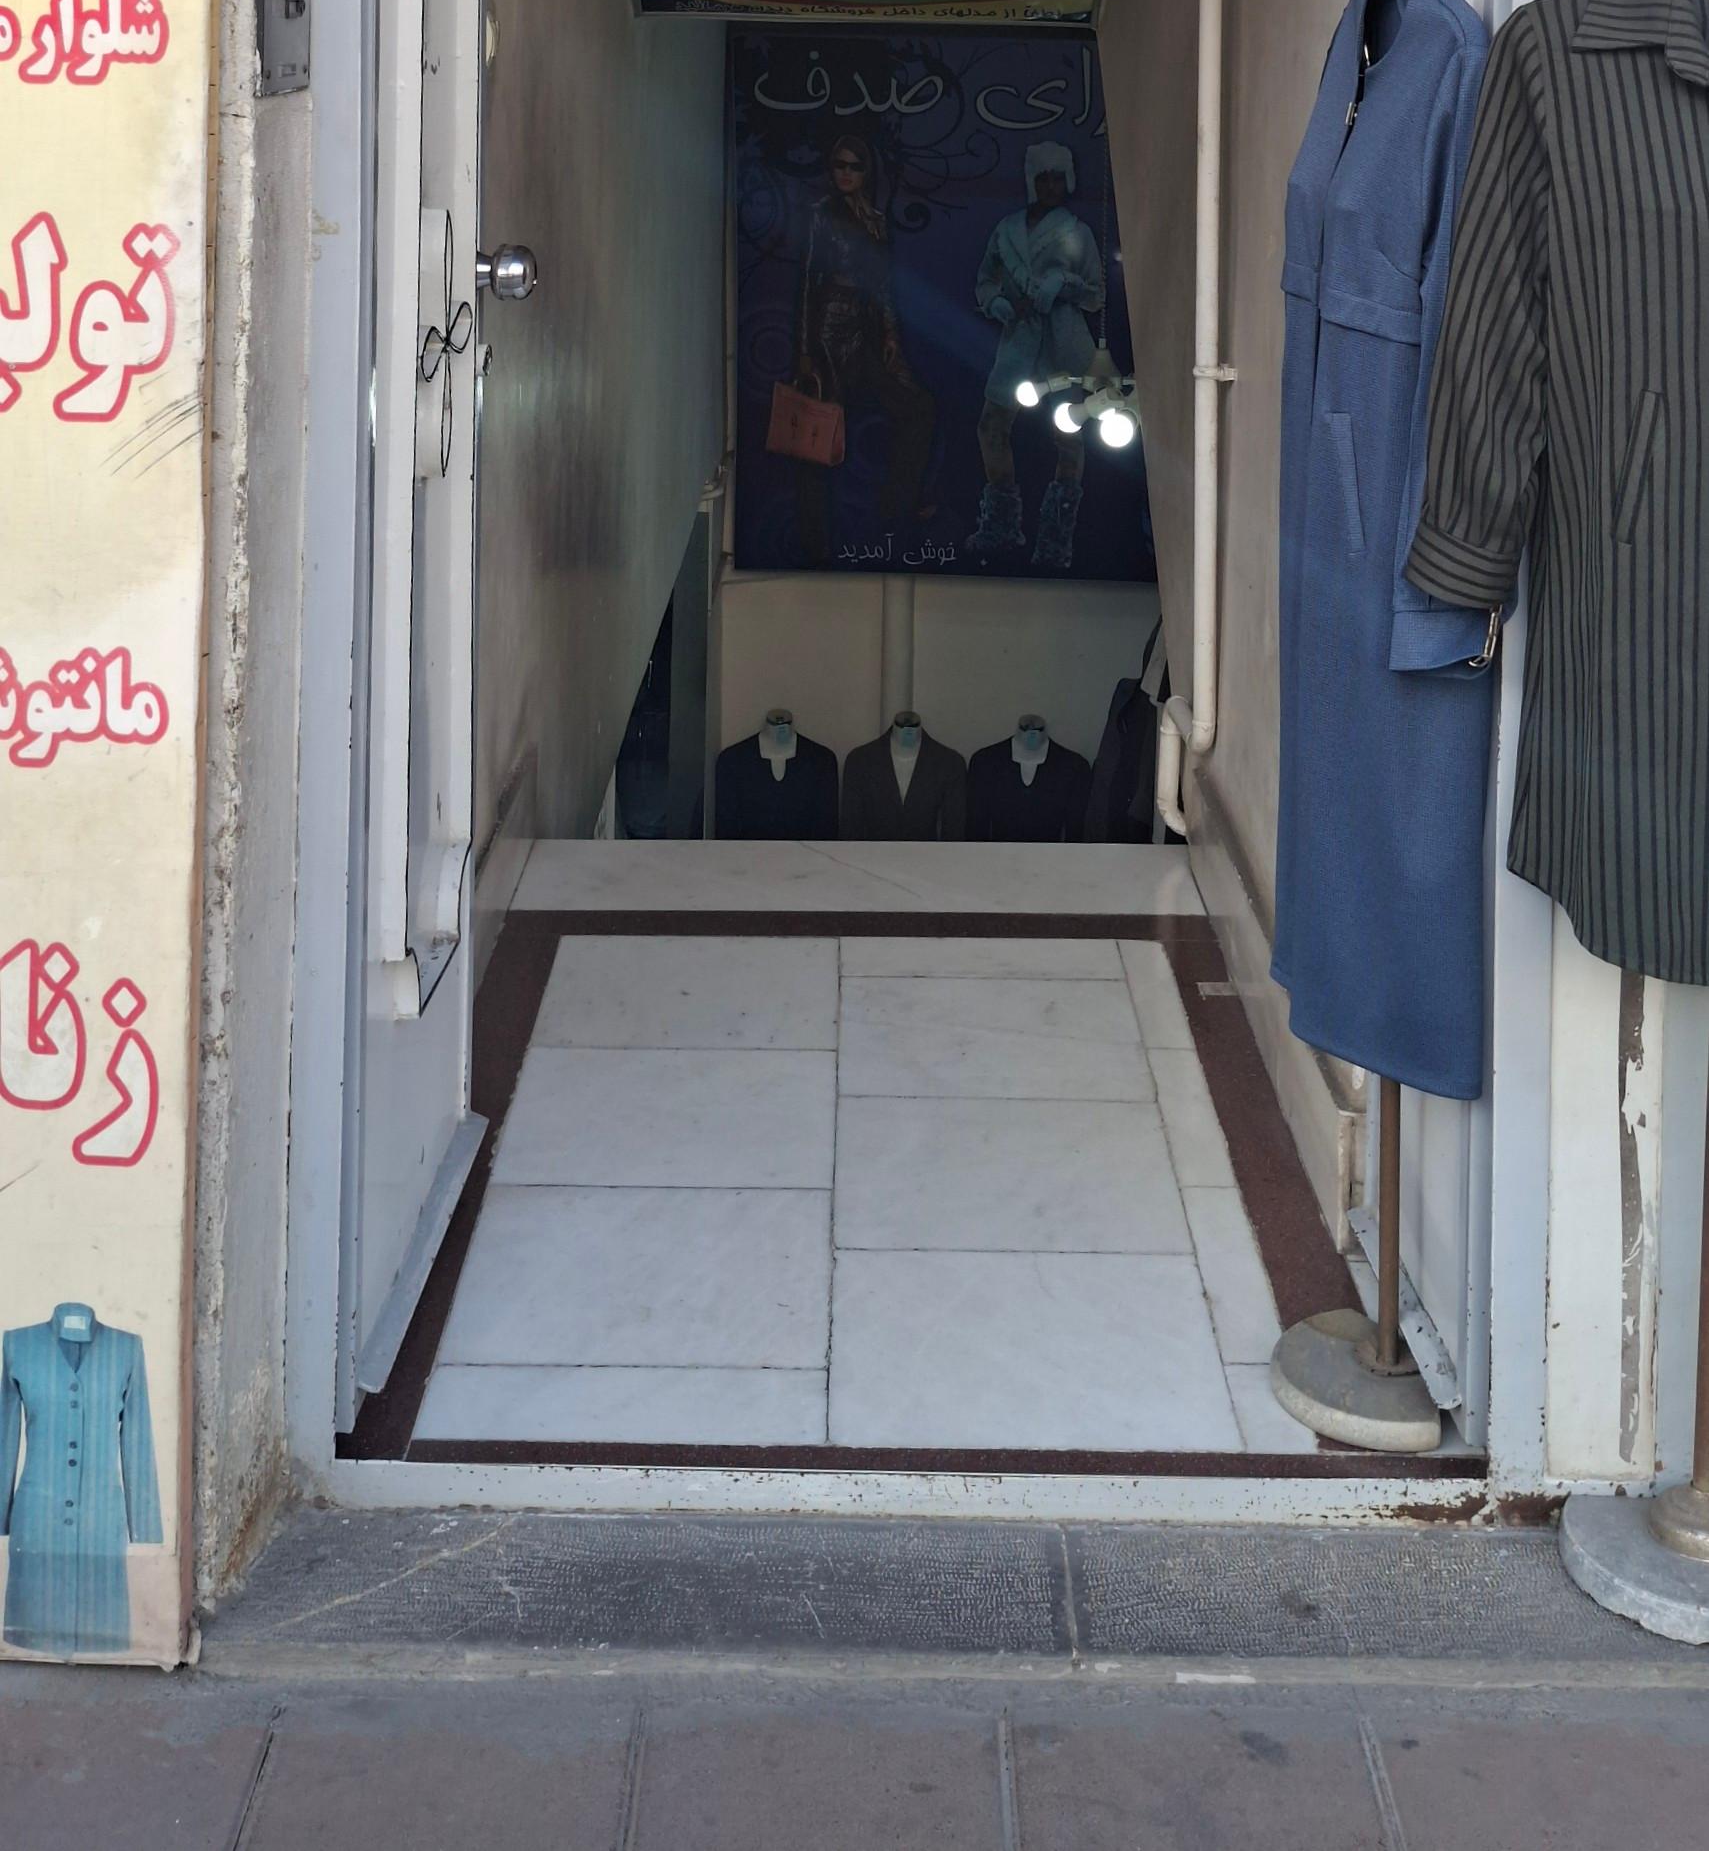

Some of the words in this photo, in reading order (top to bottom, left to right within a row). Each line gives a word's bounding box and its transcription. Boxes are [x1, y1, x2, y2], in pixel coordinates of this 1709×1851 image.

[754, 51, 943, 117] صدف
[838, 533, 895, 563] آمدید
[903, 538, 958, 565] خوش
